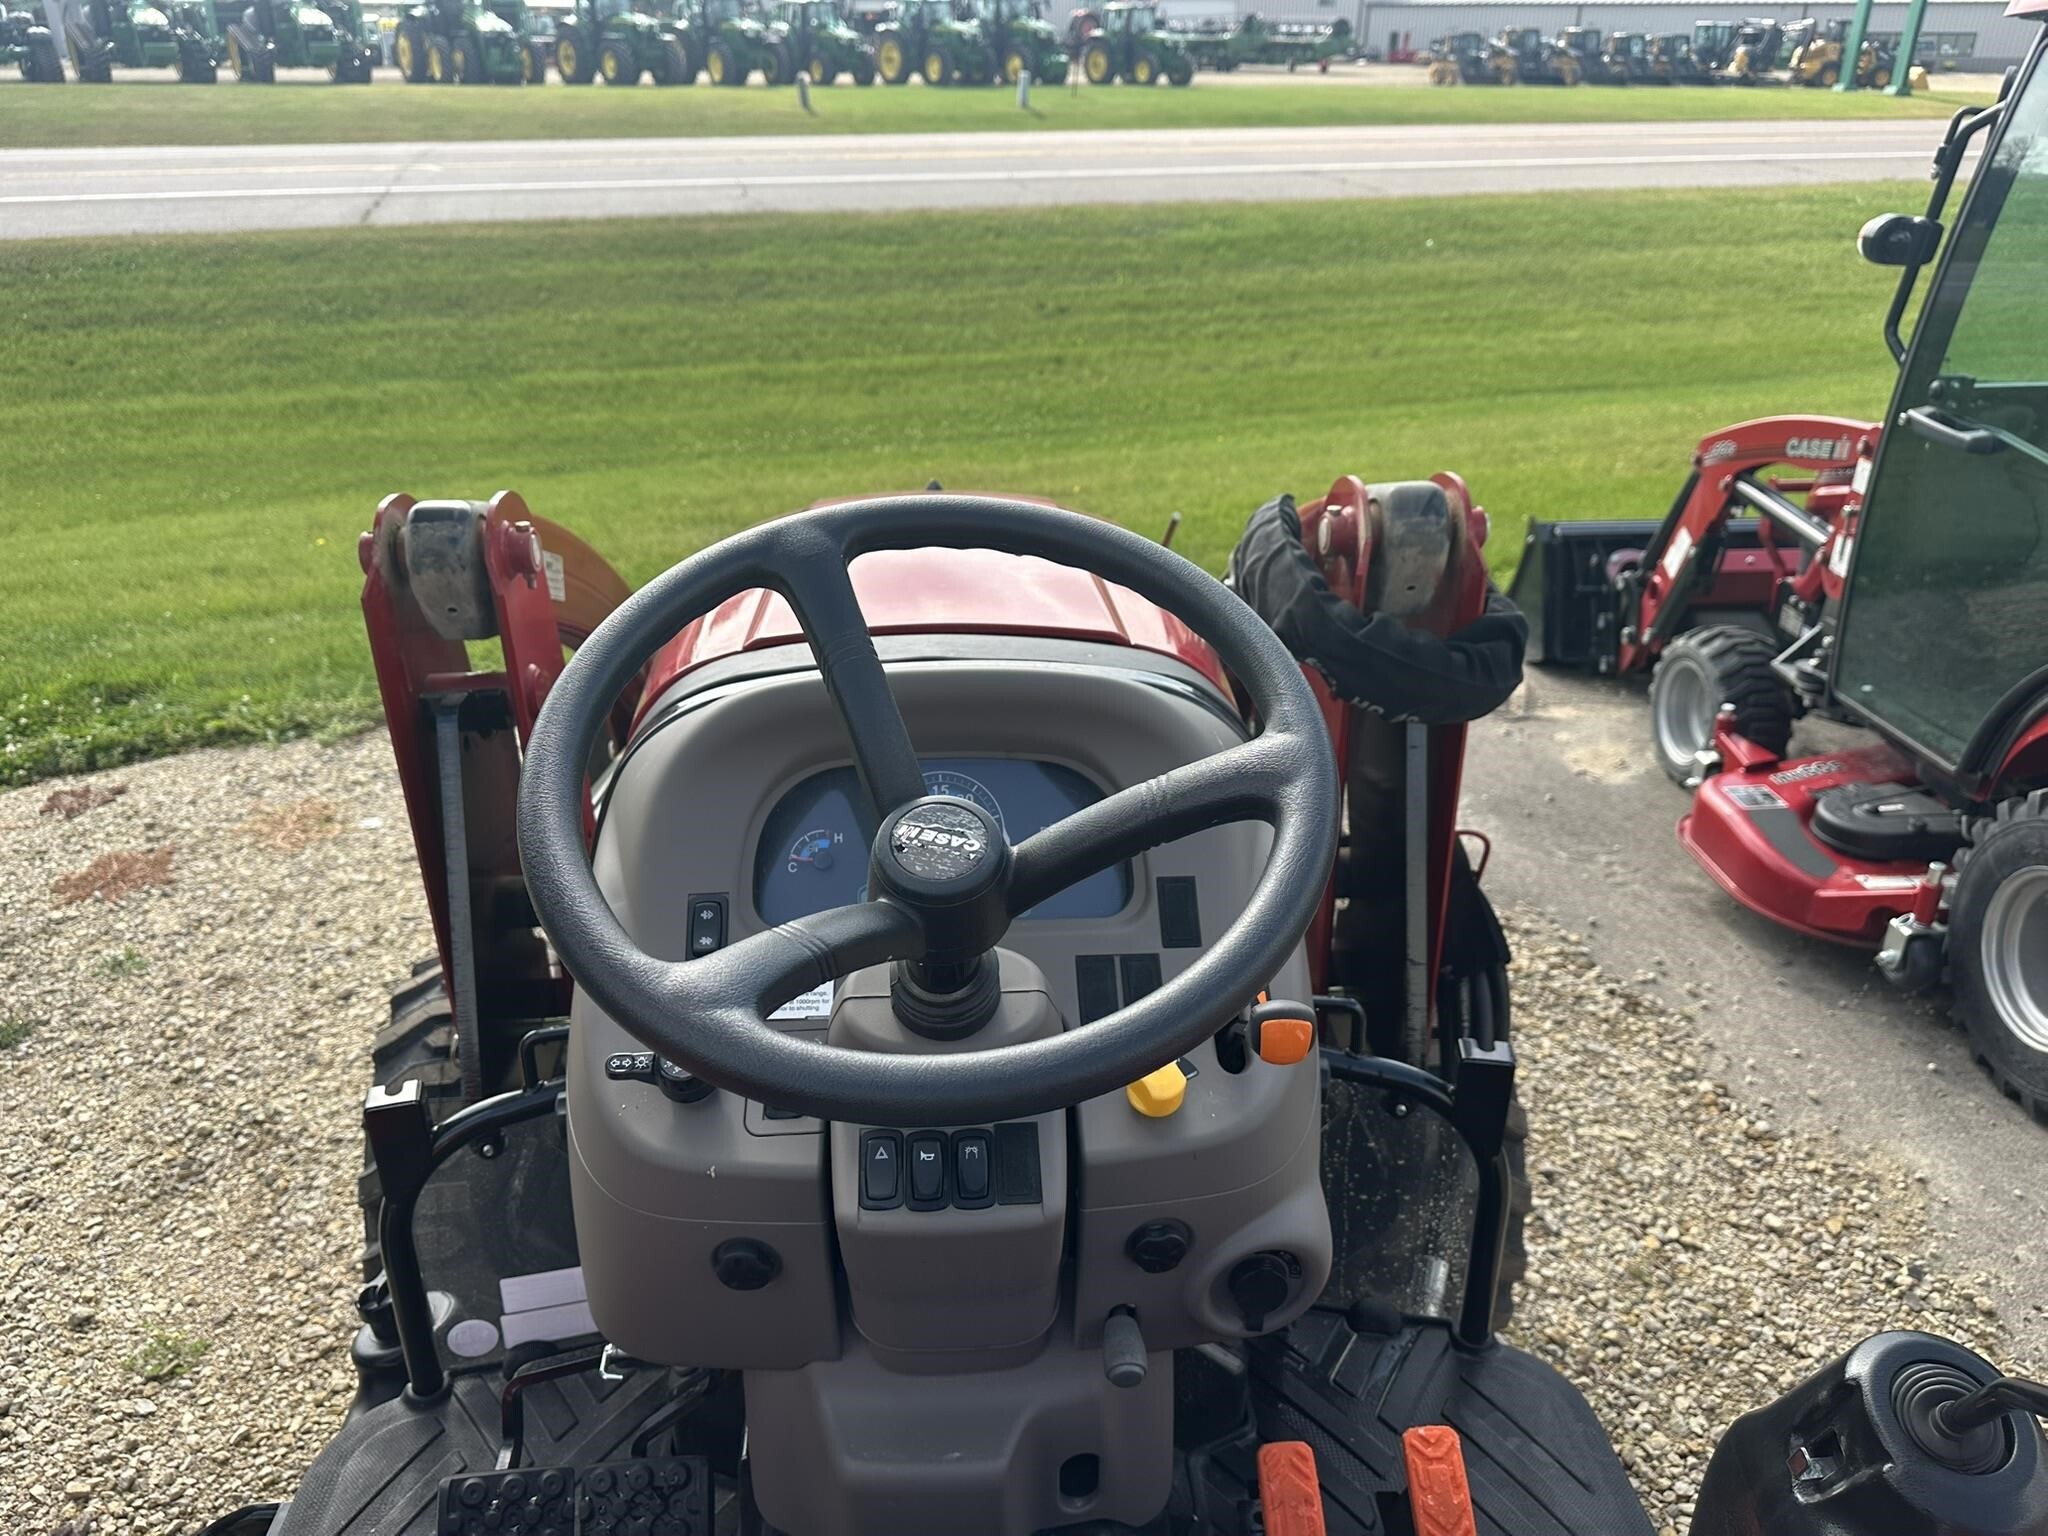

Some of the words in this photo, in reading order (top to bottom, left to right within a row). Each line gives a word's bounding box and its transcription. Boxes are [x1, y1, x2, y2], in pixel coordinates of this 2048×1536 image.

[1785, 437, 1834, 458] CASE
[931, 784, 950, 796] 15
[834, 832, 843, 844] H
[918, 828, 981, 851] CASE
[787, 862, 798, 873] C
